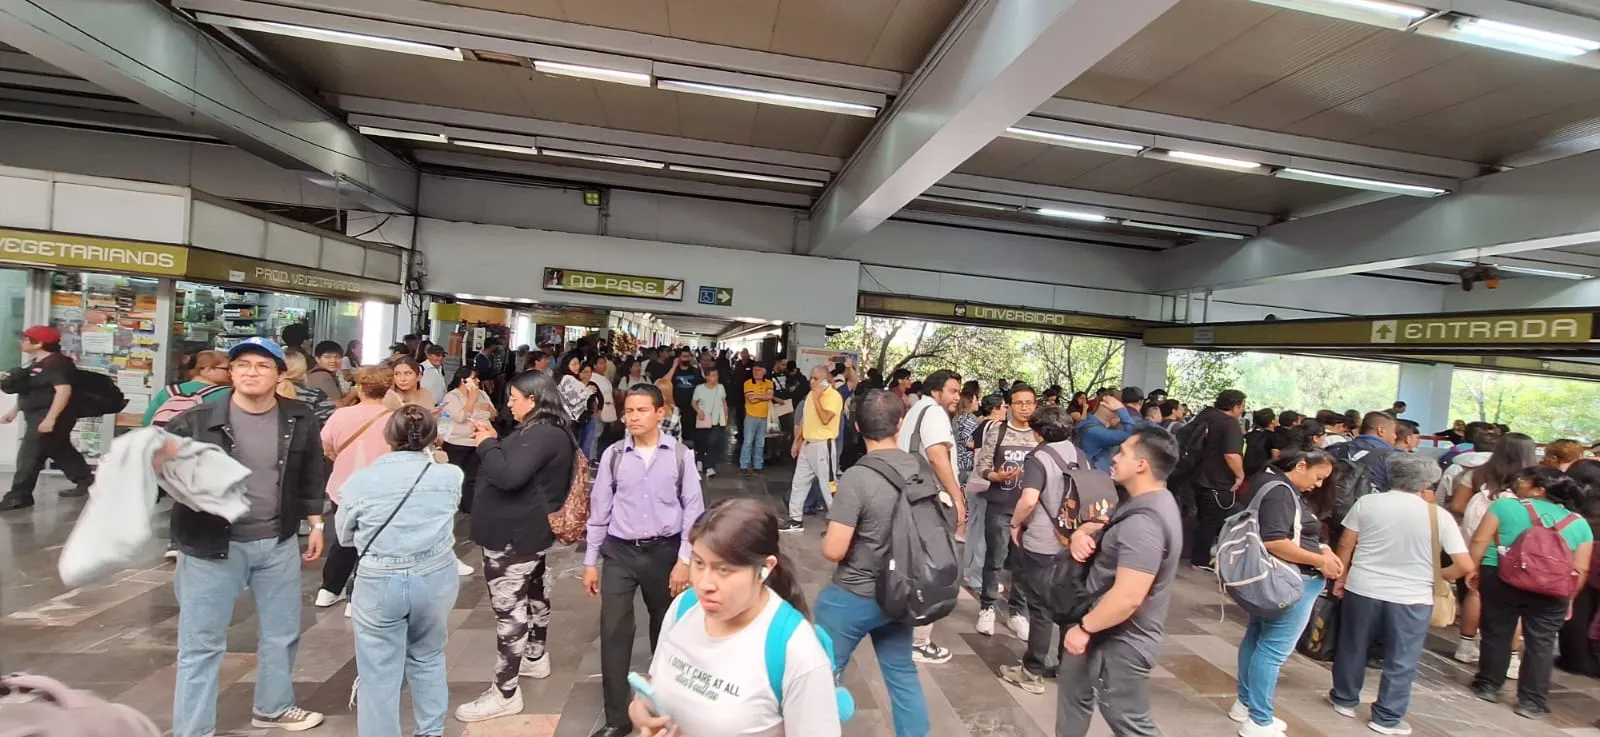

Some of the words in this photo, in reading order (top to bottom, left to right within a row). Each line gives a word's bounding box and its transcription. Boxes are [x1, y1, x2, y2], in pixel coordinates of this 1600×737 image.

[256, 267, 290, 284] PROD.
[570, 274, 597, 289] NO
[605, 278, 658, 293] PASE
[974, 307, 1065, 325] UNIVERSIDAD
[1404, 318, 1578, 339] ENTRADA
[693, 668, 712, 682] CARE
[712, 677, 724, 690] AT
[724, 682, 740, 697] ALL
